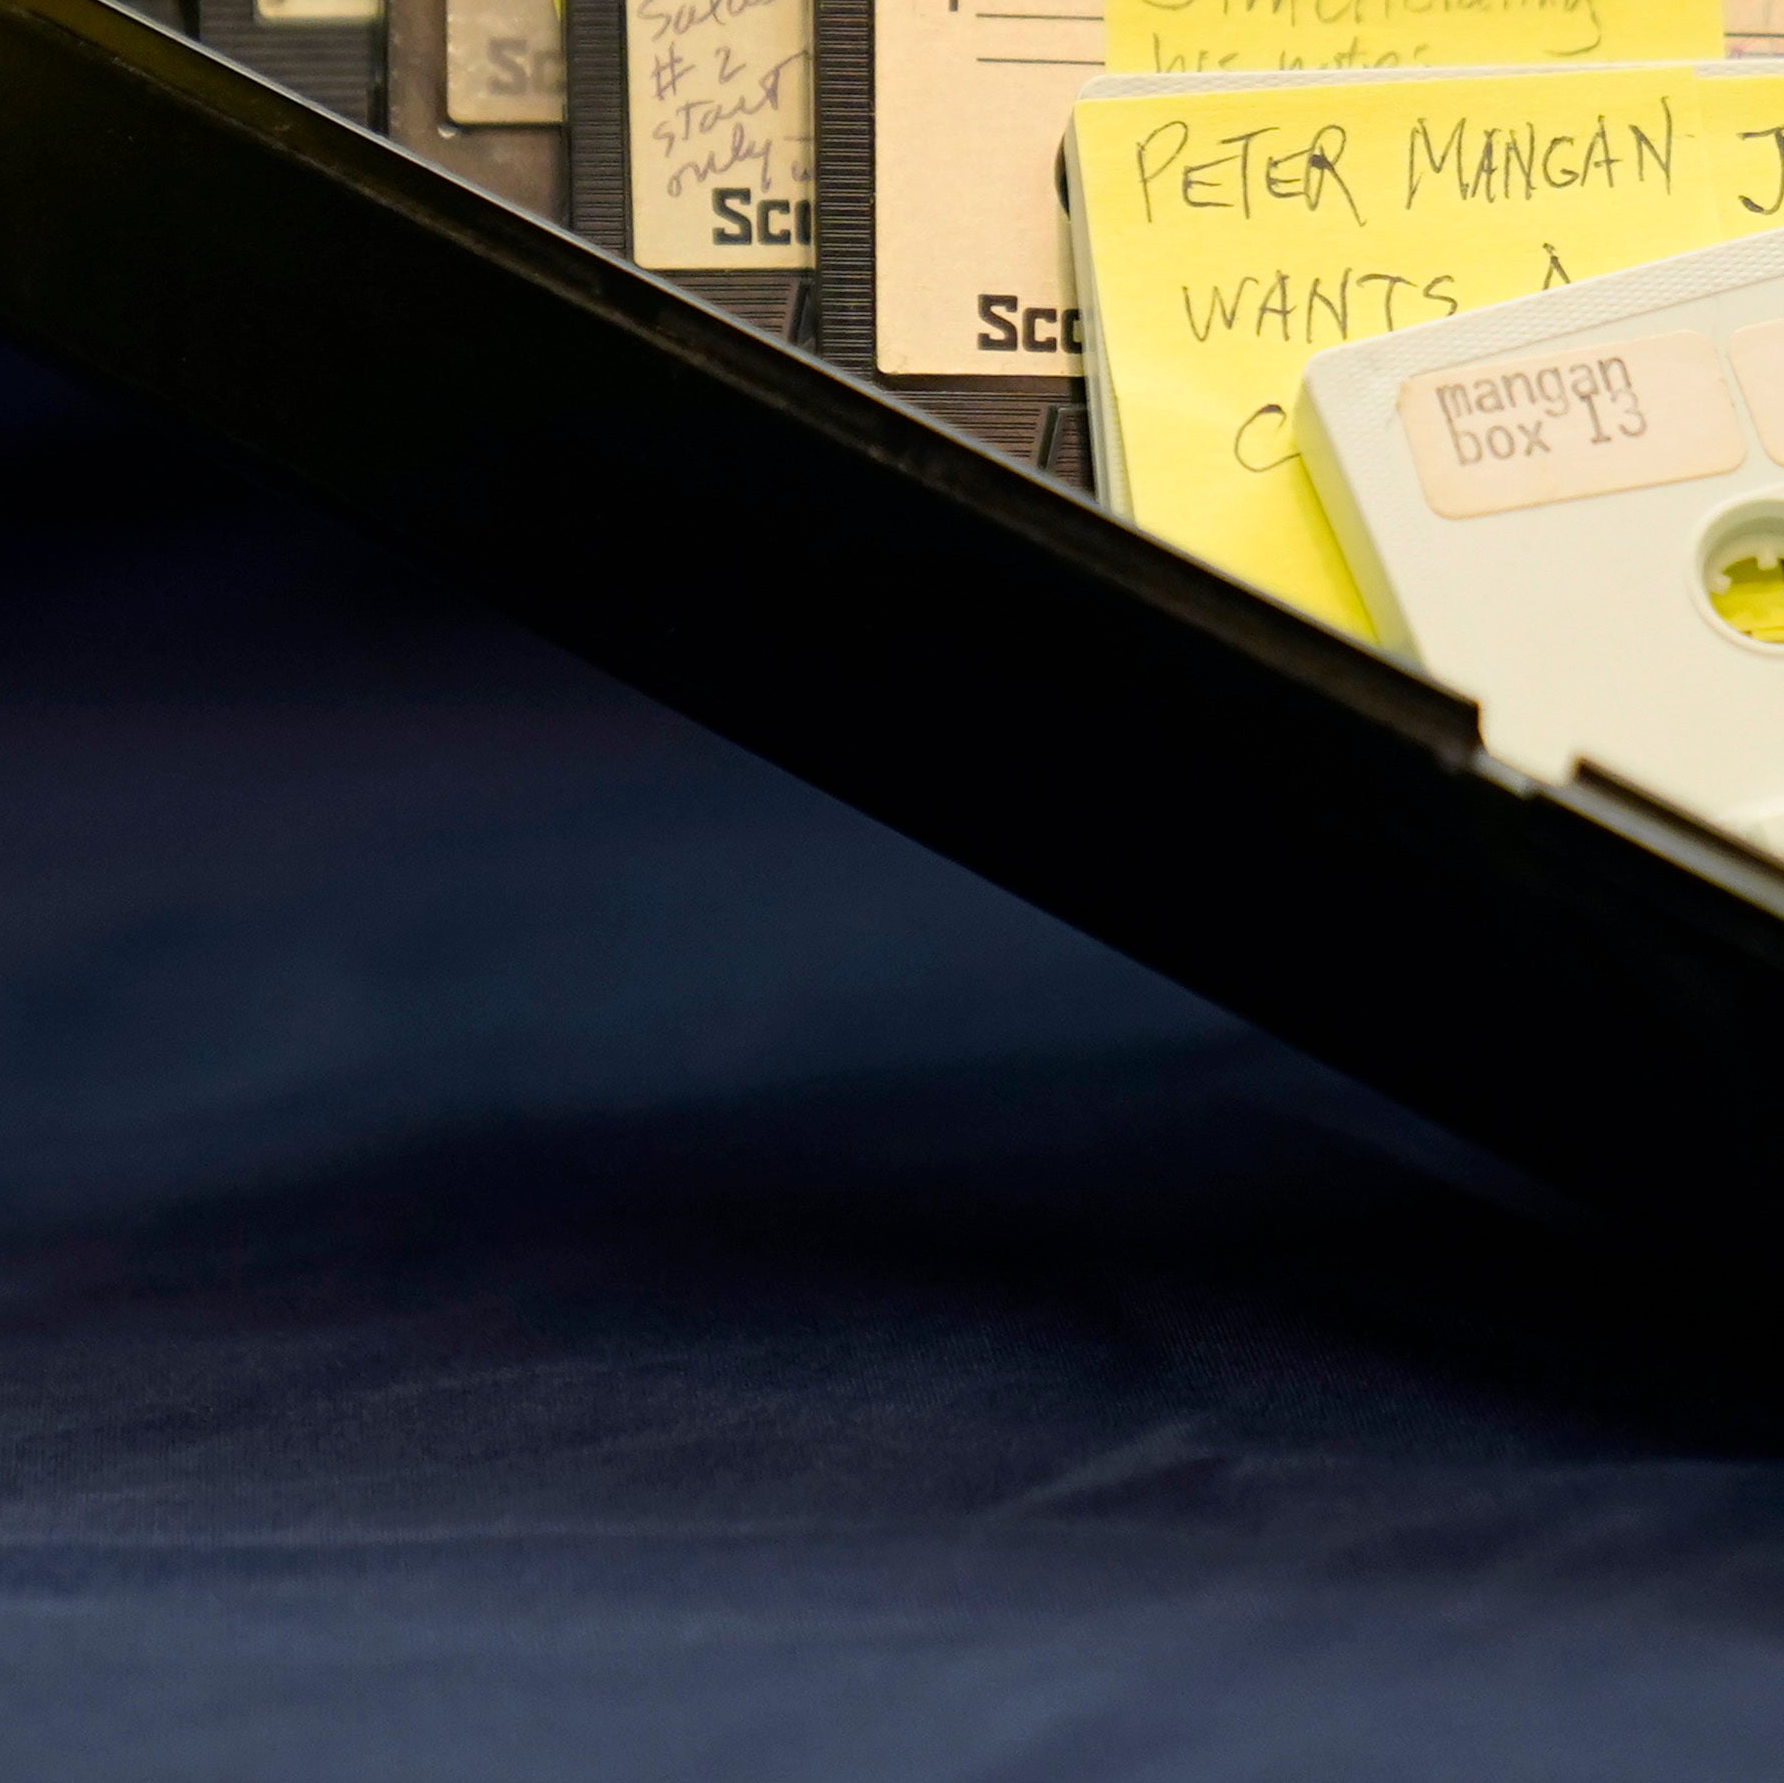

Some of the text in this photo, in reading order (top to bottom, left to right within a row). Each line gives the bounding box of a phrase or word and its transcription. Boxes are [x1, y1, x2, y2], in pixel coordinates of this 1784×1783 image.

[667, 121, 773, 198] only
[1136, 96, 1675, 226] PETER MANGAN
[1182, 266, 1459, 343] WANTS
[1436, 357, 1632, 418] mangan
[1439, 389, 1551, 466] box
